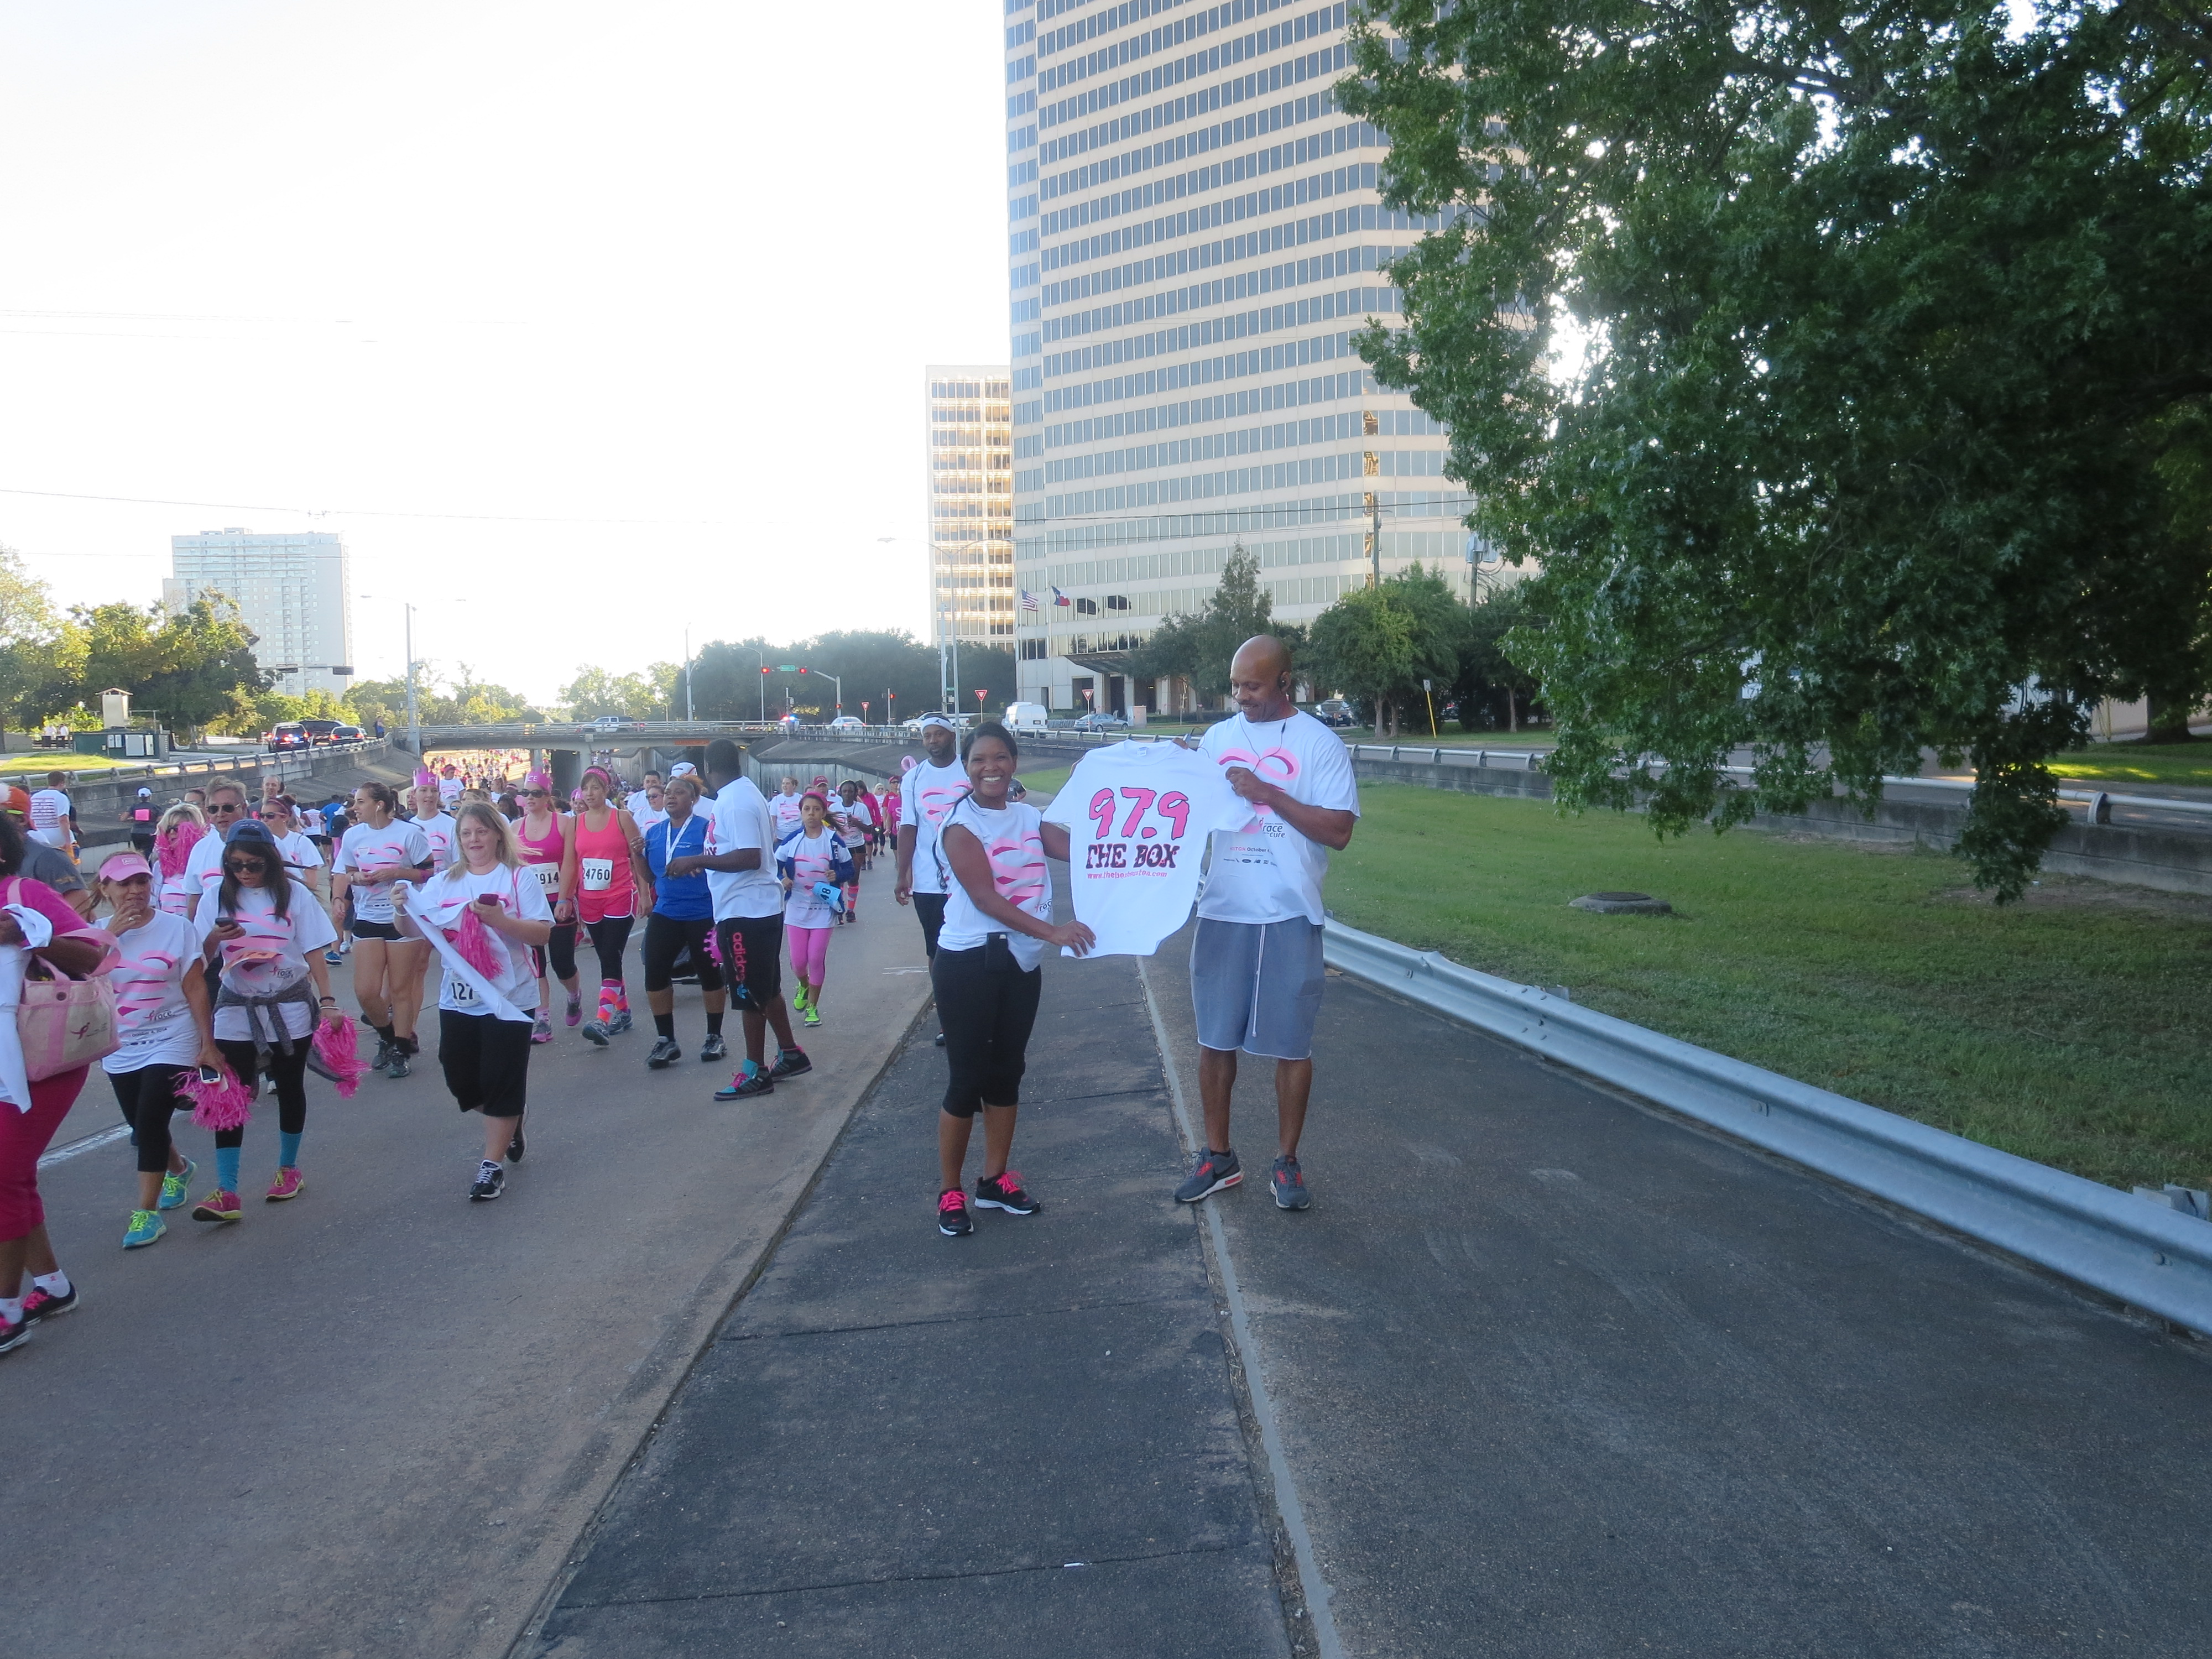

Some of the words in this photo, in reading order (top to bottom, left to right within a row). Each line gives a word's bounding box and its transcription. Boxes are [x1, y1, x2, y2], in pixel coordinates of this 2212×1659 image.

[1089, 787, 1190, 841] 97.9
[1086, 843, 1126, 869] THE
[1133, 843, 1180, 869] BOX
[1039, 901, 1052, 912] rac
